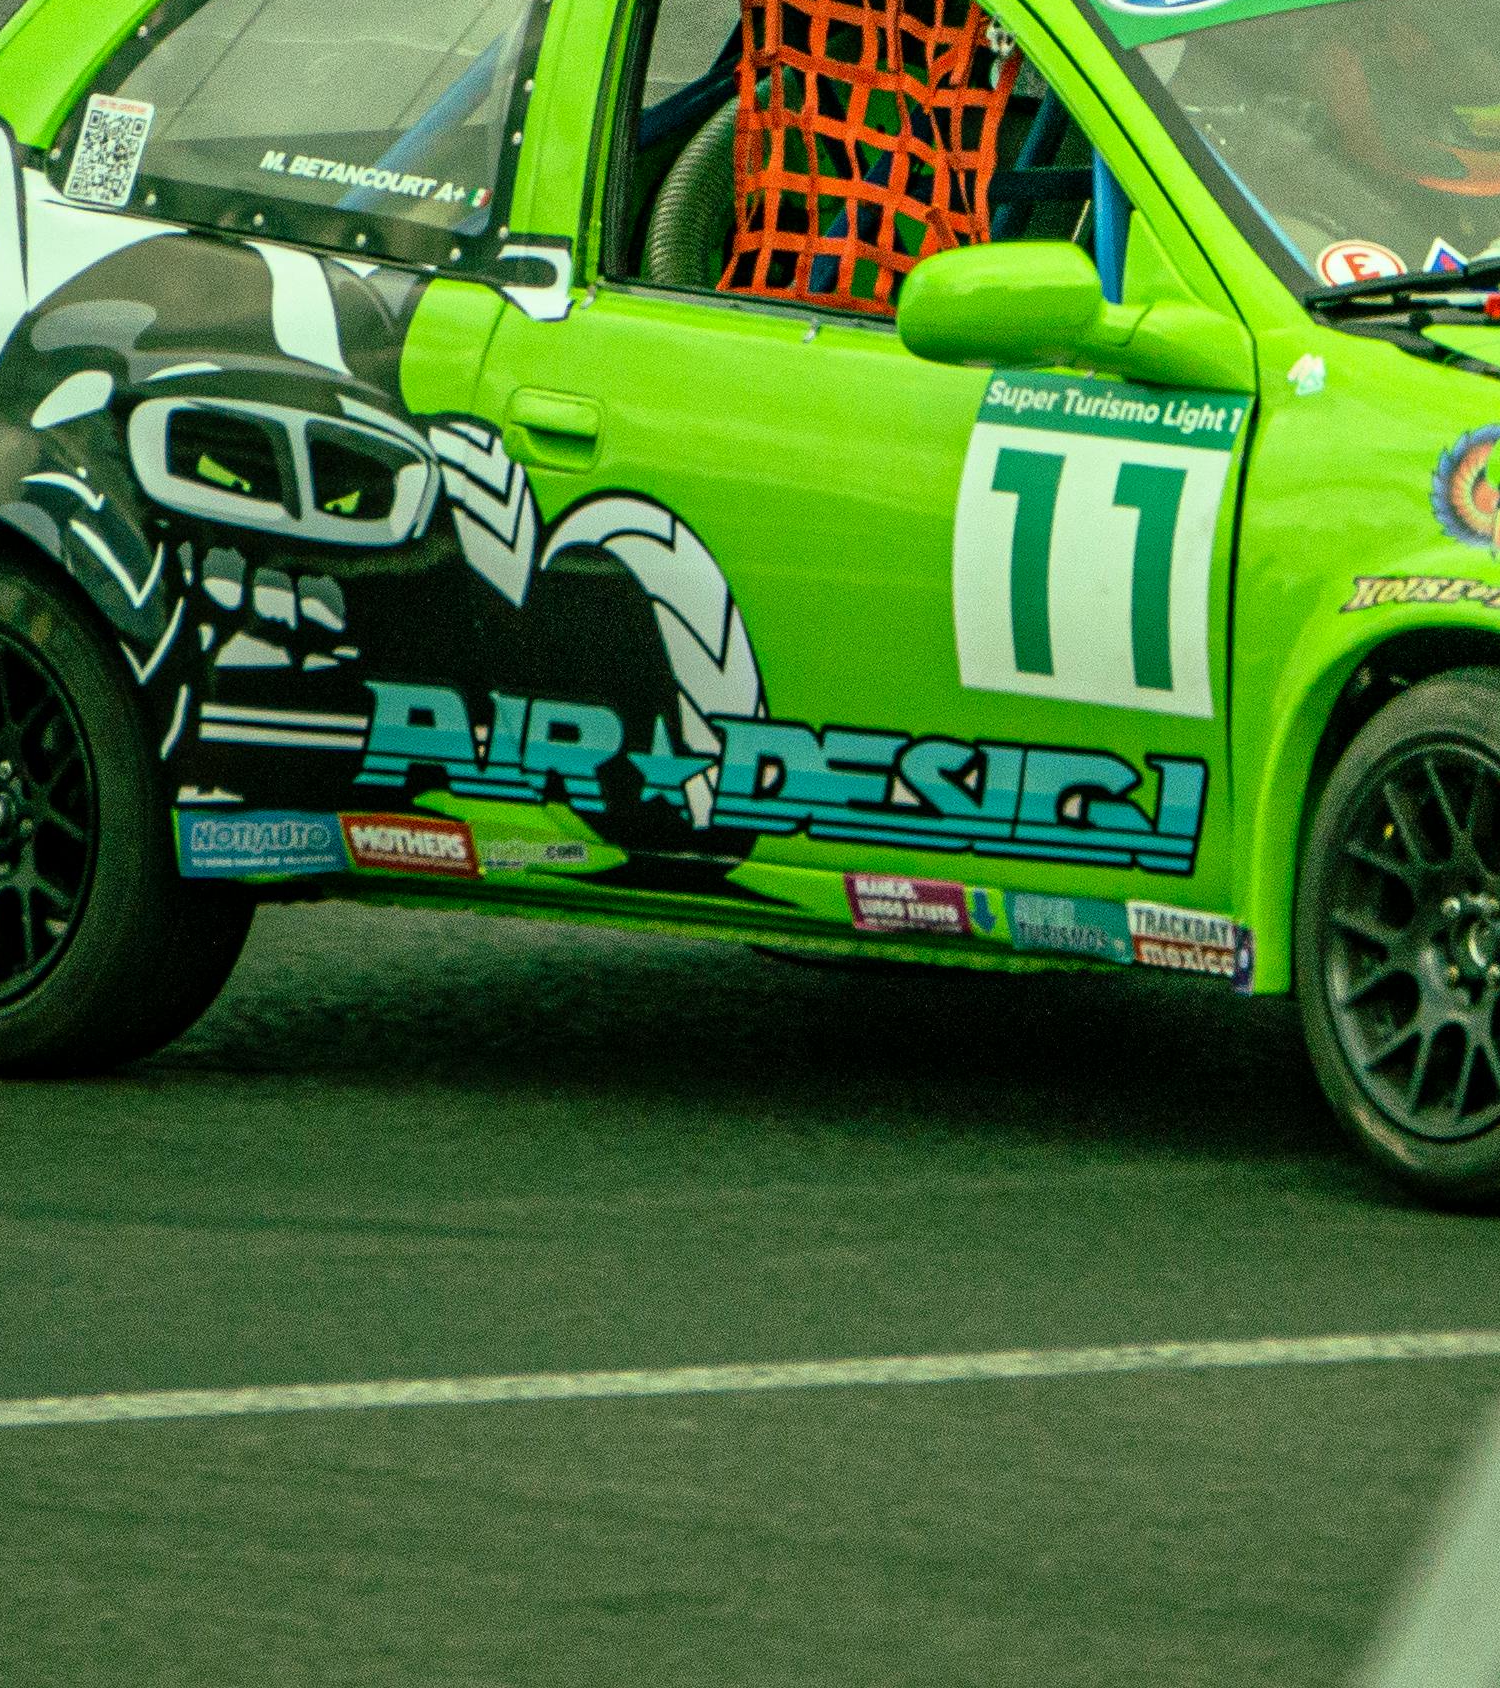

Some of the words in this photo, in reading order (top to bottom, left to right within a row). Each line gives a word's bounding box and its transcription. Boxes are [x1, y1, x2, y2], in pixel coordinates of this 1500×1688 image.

[258, 150, 286, 172] M.
[288, 155, 438, 198] BETANCOURT
[433, 181, 466, 202] A+
[986, 378, 1059, 414] Super
[1064, 387, 1161, 424] Turismo
[1162, 399, 1227, 435] Light
[1229, 407, 1244, 434] 1
[991, 446, 1189, 692] 11
[352, 680, 625, 813] AIR
[190, 820, 331, 855] NOTIAUTO
[349, 825, 467, 860] MOTHERS
[1133, 906, 1230, 946] TRACKDAY
